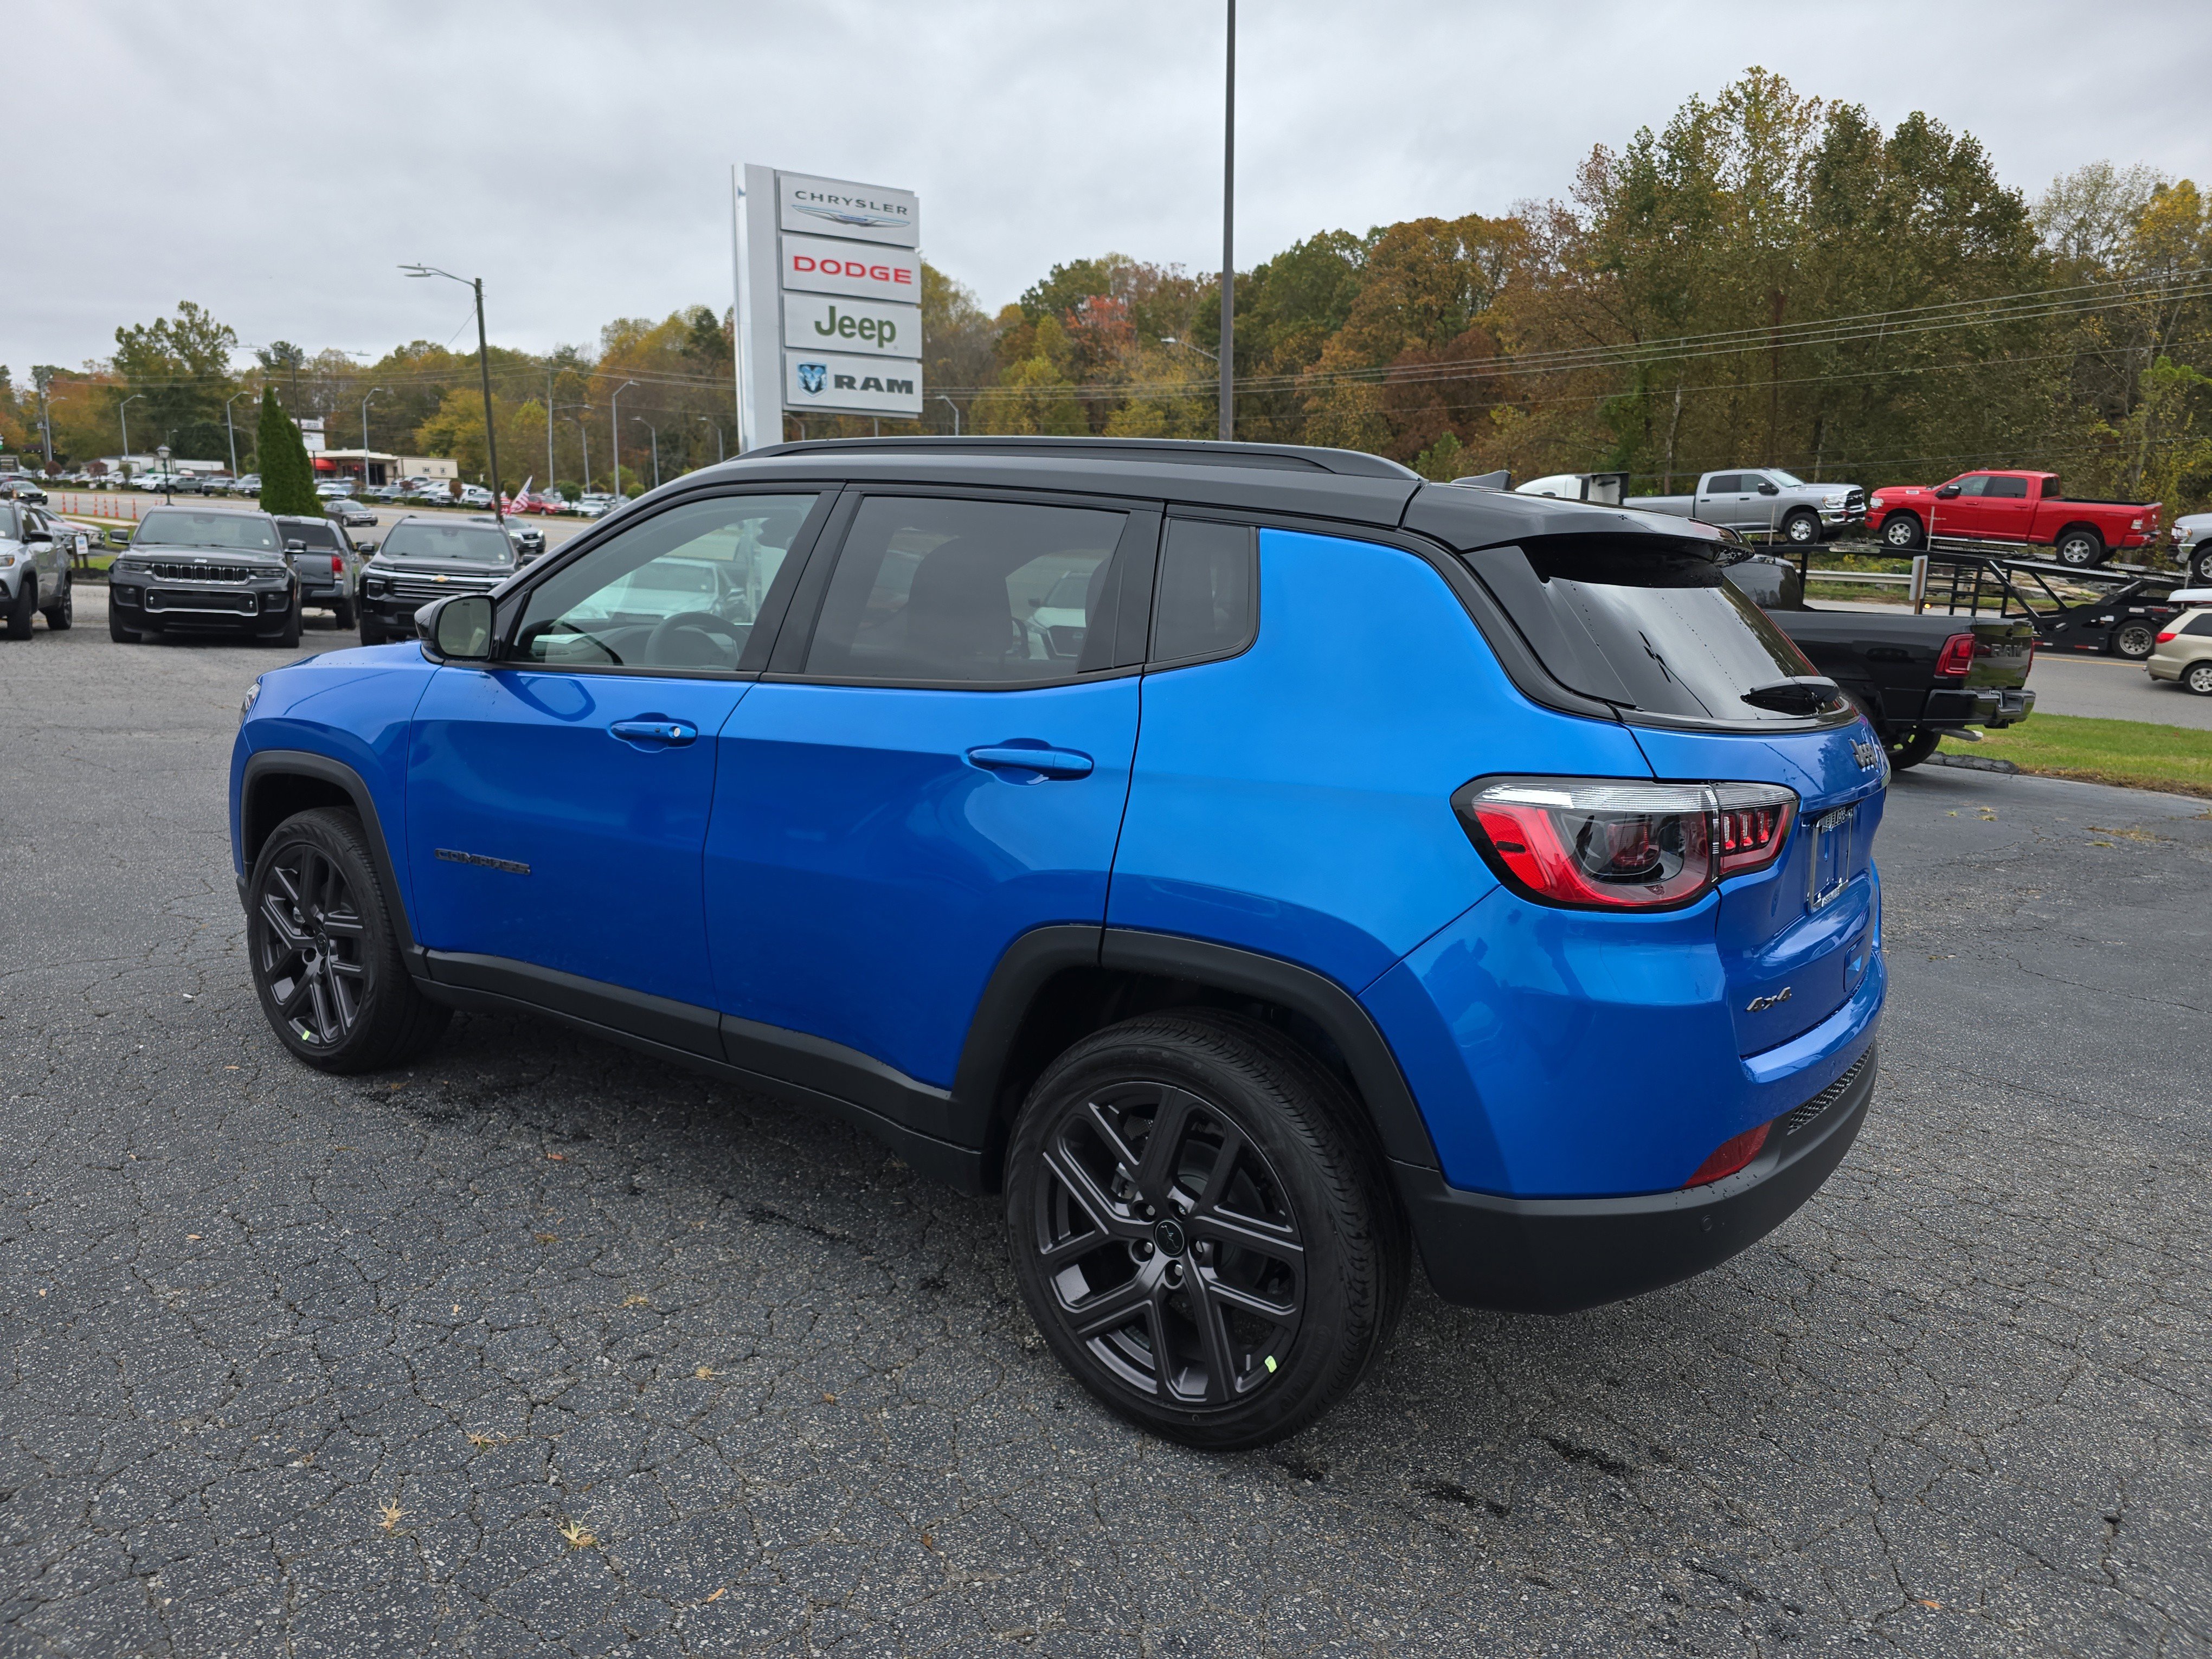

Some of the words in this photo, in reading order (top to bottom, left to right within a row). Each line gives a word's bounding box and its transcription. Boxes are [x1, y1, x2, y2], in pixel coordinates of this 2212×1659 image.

[795, 190, 908, 215] CHRYSLER
[793, 255, 912, 285] DODGE
[814, 305, 896, 348] Jeep
[834, 374, 914, 395] RAM
